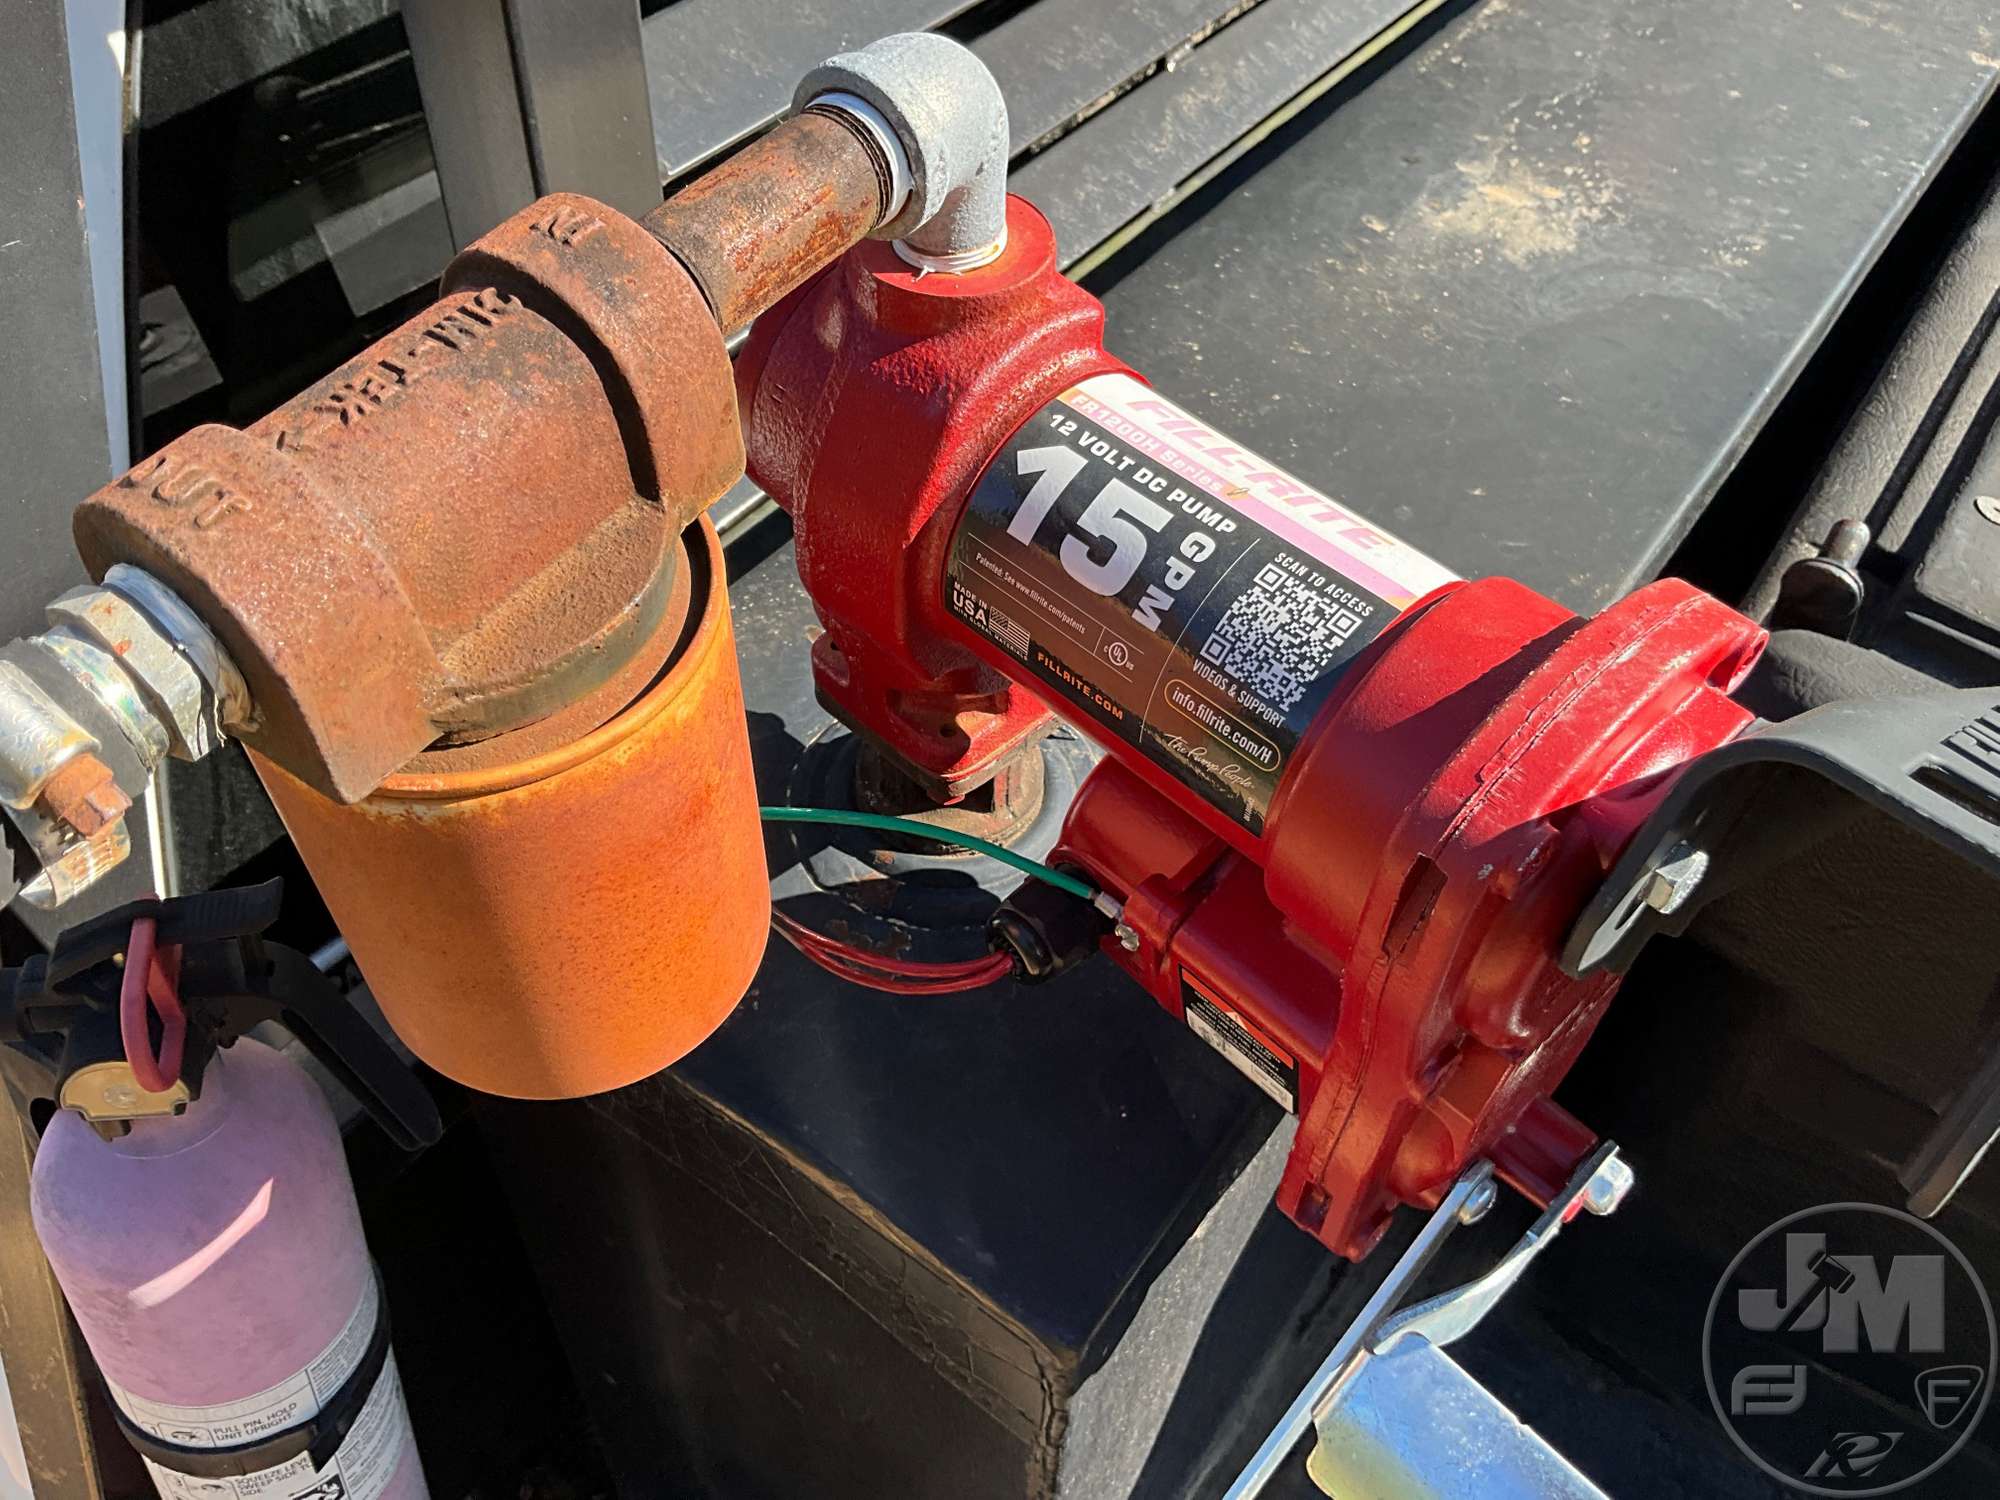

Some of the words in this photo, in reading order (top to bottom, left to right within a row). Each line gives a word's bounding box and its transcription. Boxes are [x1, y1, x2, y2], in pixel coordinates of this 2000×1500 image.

[1050, 414, 1078, 436] 12
[1078, 431, 1136, 471] VOLT
[1132, 467, 1168, 493] DC
[1166, 488, 1237, 533] PUMP
[1125, 400, 1394, 549] FILL-RITE
[1159, 449, 1225, 492] Series
[1006, 445, 1174, 597] 15
[953, 590, 987, 627] USA
[954, 581, 977, 603] MADE
[979, 599, 988, 610] IN
[1004, 572, 1015, 585] See
[1015, 581, 1086, 635] www.fillrite.com/patents
[1274, 552, 1309, 576] SCAN
[1307, 572, 1326, 587] TO
[1324, 584, 1374, 617] ACCESS
[1038, 652, 1123, 720] FILLRITE.COM
[1193, 659, 1229, 691] VIDEOS
[1227, 684, 1237, 698] &
[1237, 690, 1286, 729] SUPPORT
[1172, 687, 1273, 764] info.fillrite.com/H
[213, 1424, 240, 1434] PULL
[266, 1402, 297, 1425] HOLD
[216, 1431, 242, 1441] UNIT
[234, 1466, 282, 1484] SQUEEZE
[237, 1478, 274, 1490] SWEEP
[275, 1470, 297, 1482] SIDE
